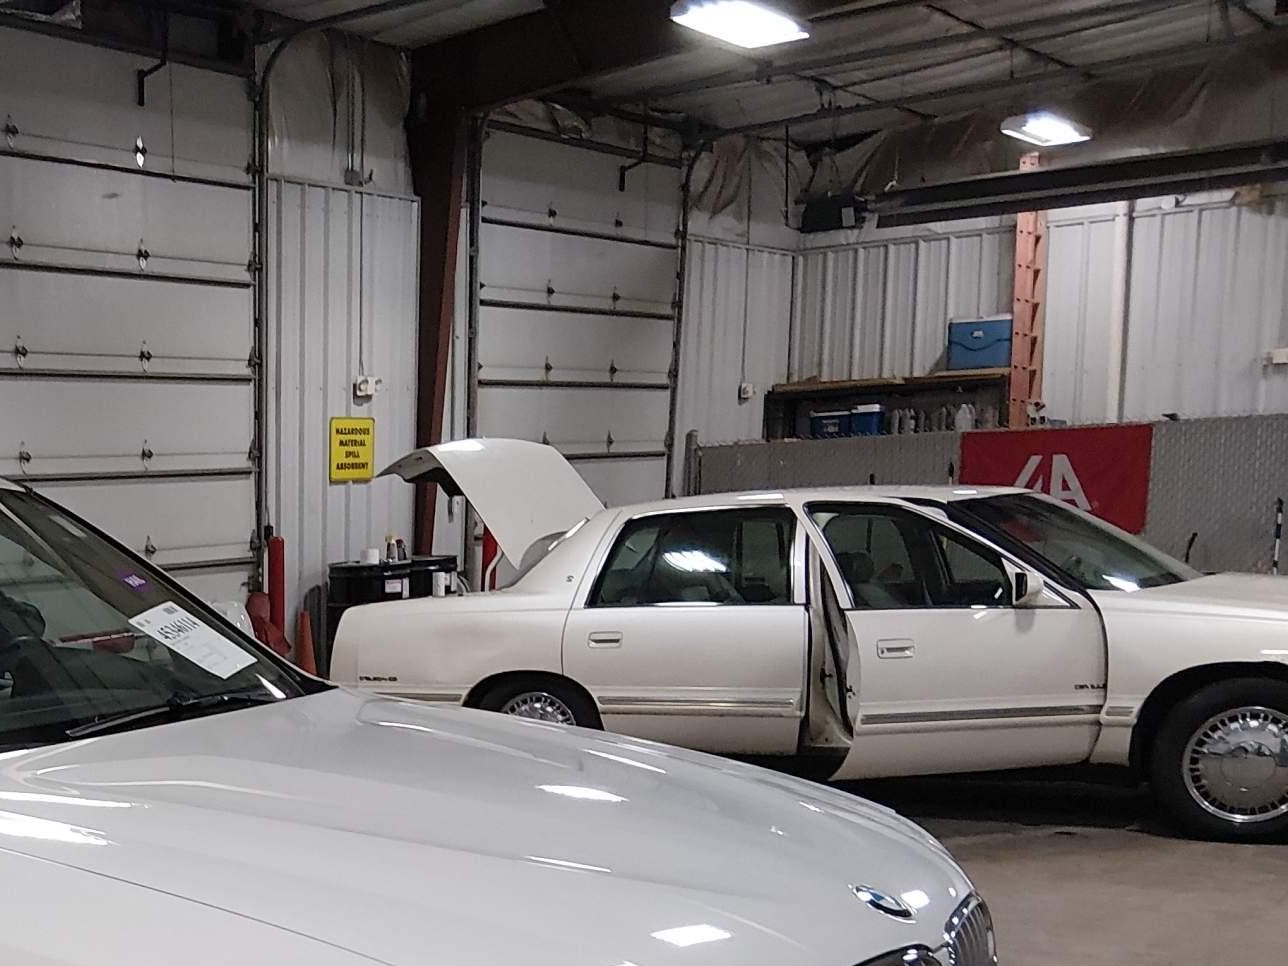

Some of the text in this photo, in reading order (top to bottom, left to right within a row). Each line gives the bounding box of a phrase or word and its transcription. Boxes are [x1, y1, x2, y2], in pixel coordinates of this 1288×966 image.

[335, 427, 370, 436] HAZARDOUS
[338, 439, 367, 447] MATERIAL
[345, 450, 360, 459] SPILL
[336, 462, 369, 471] ABSORBENT
[157, 616, 201, 640] 45346114
